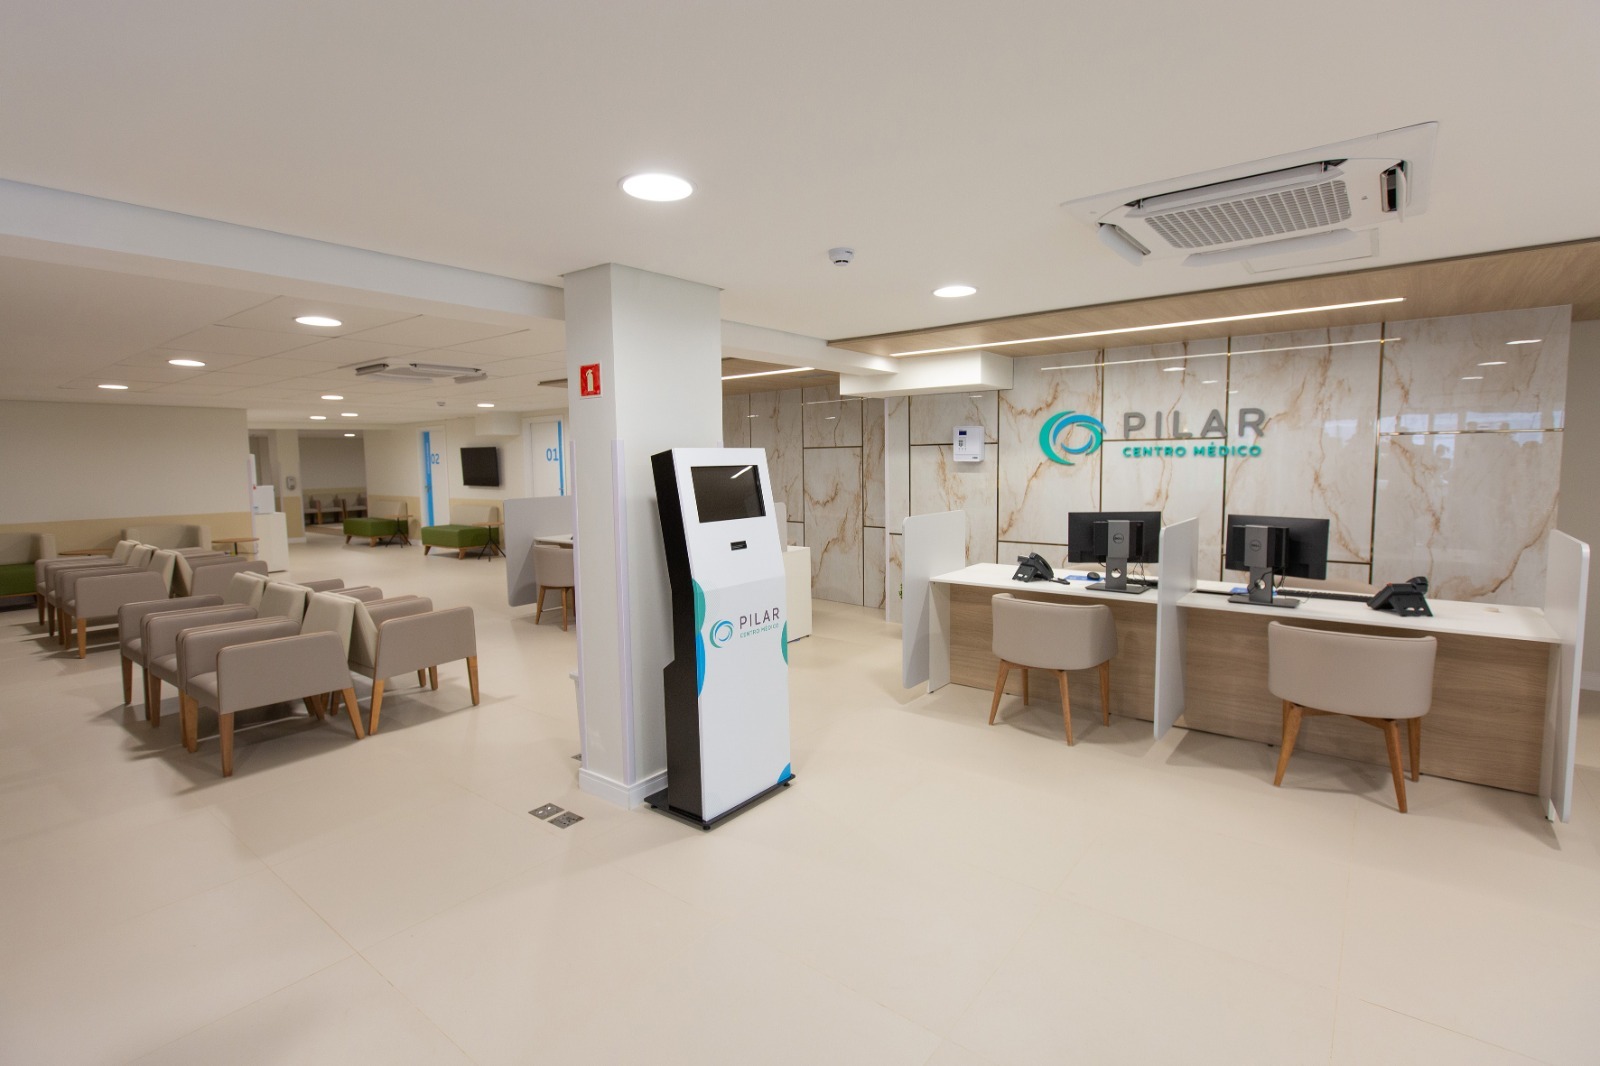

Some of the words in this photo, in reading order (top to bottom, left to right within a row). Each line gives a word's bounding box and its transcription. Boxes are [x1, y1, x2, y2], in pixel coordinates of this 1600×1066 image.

[1123, 407, 1265, 439] PILAR
[546, 448, 558, 461] 01
[1122, 445, 1187, 458] CENTRO
[1193, 442, 1262, 458] MÉDICO
[431, 453, 440, 464] 02
[739, 607, 780, 630] PILAR
